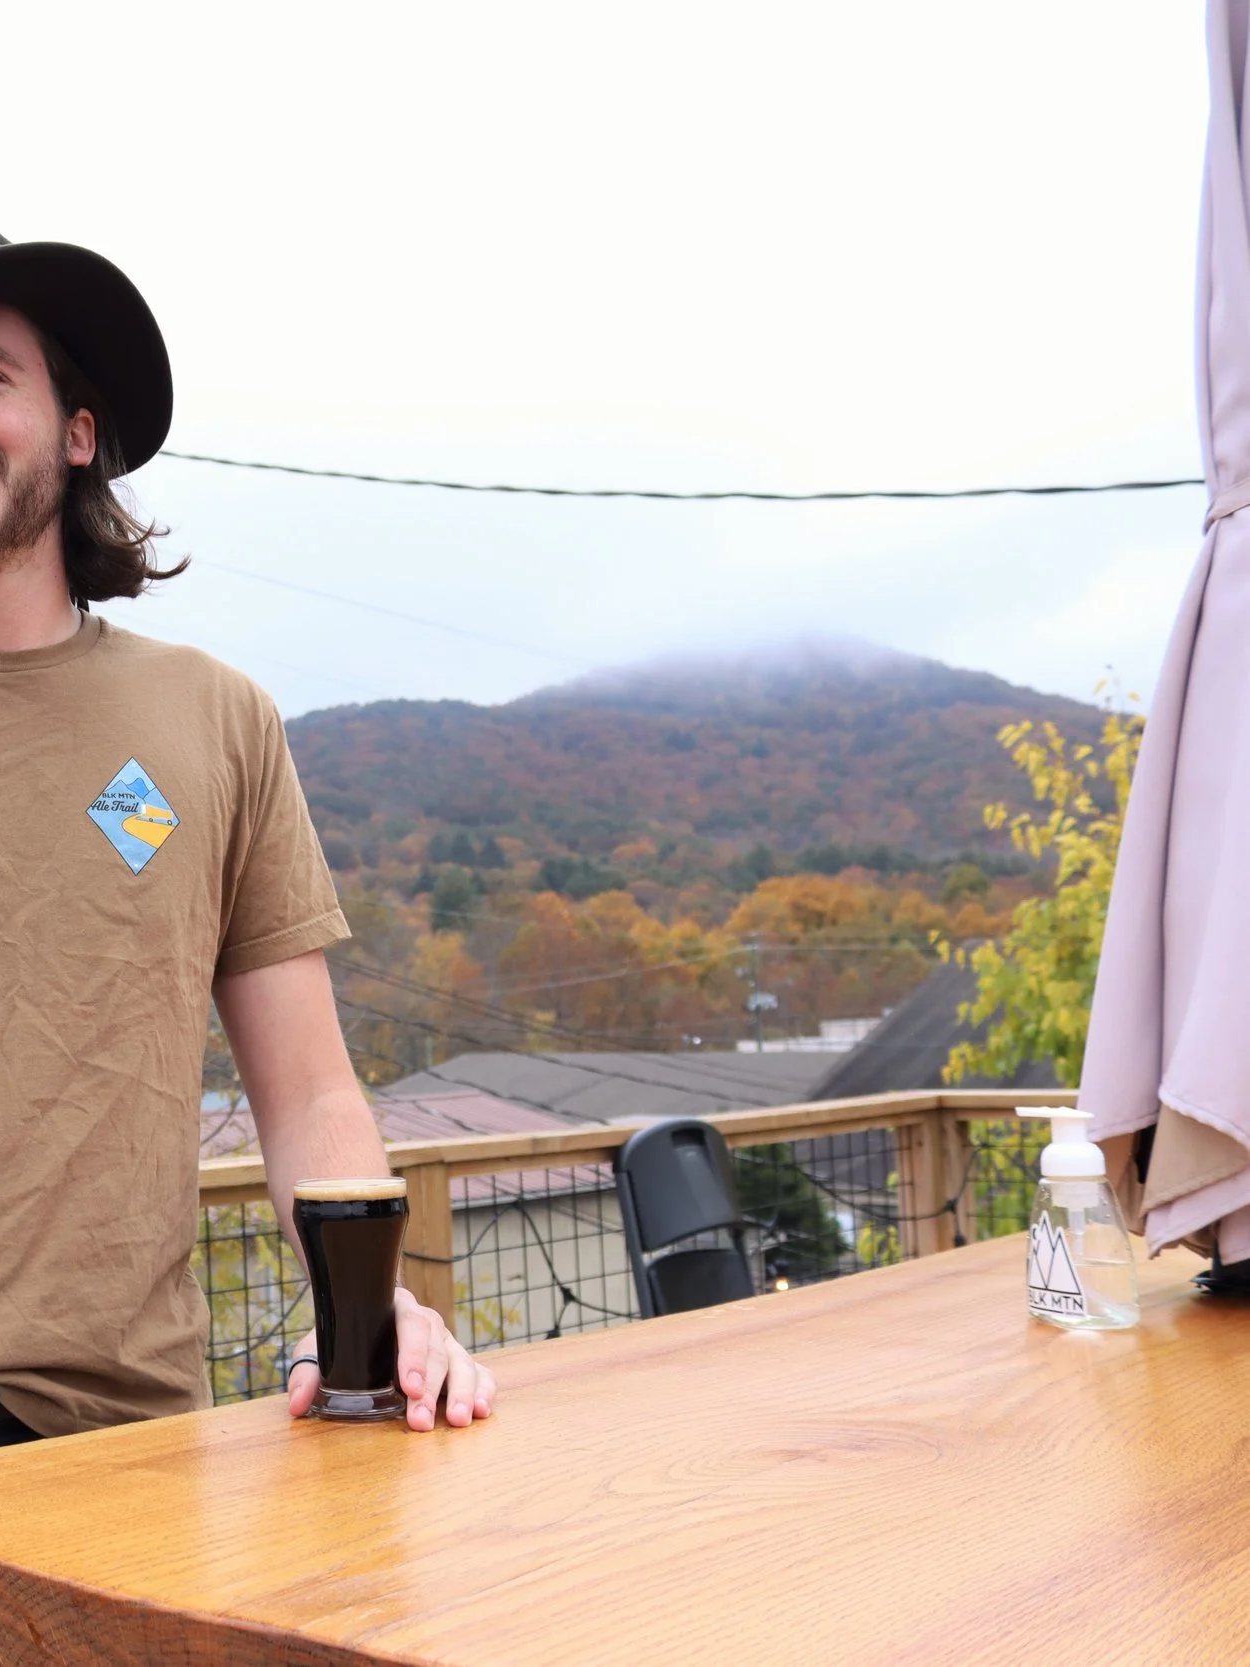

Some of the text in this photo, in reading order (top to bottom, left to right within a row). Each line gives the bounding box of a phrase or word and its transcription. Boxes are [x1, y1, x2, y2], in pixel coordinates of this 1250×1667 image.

[91, 800, 139, 813] Ale Trail
[1051, 1294, 1084, 1311] MTN
